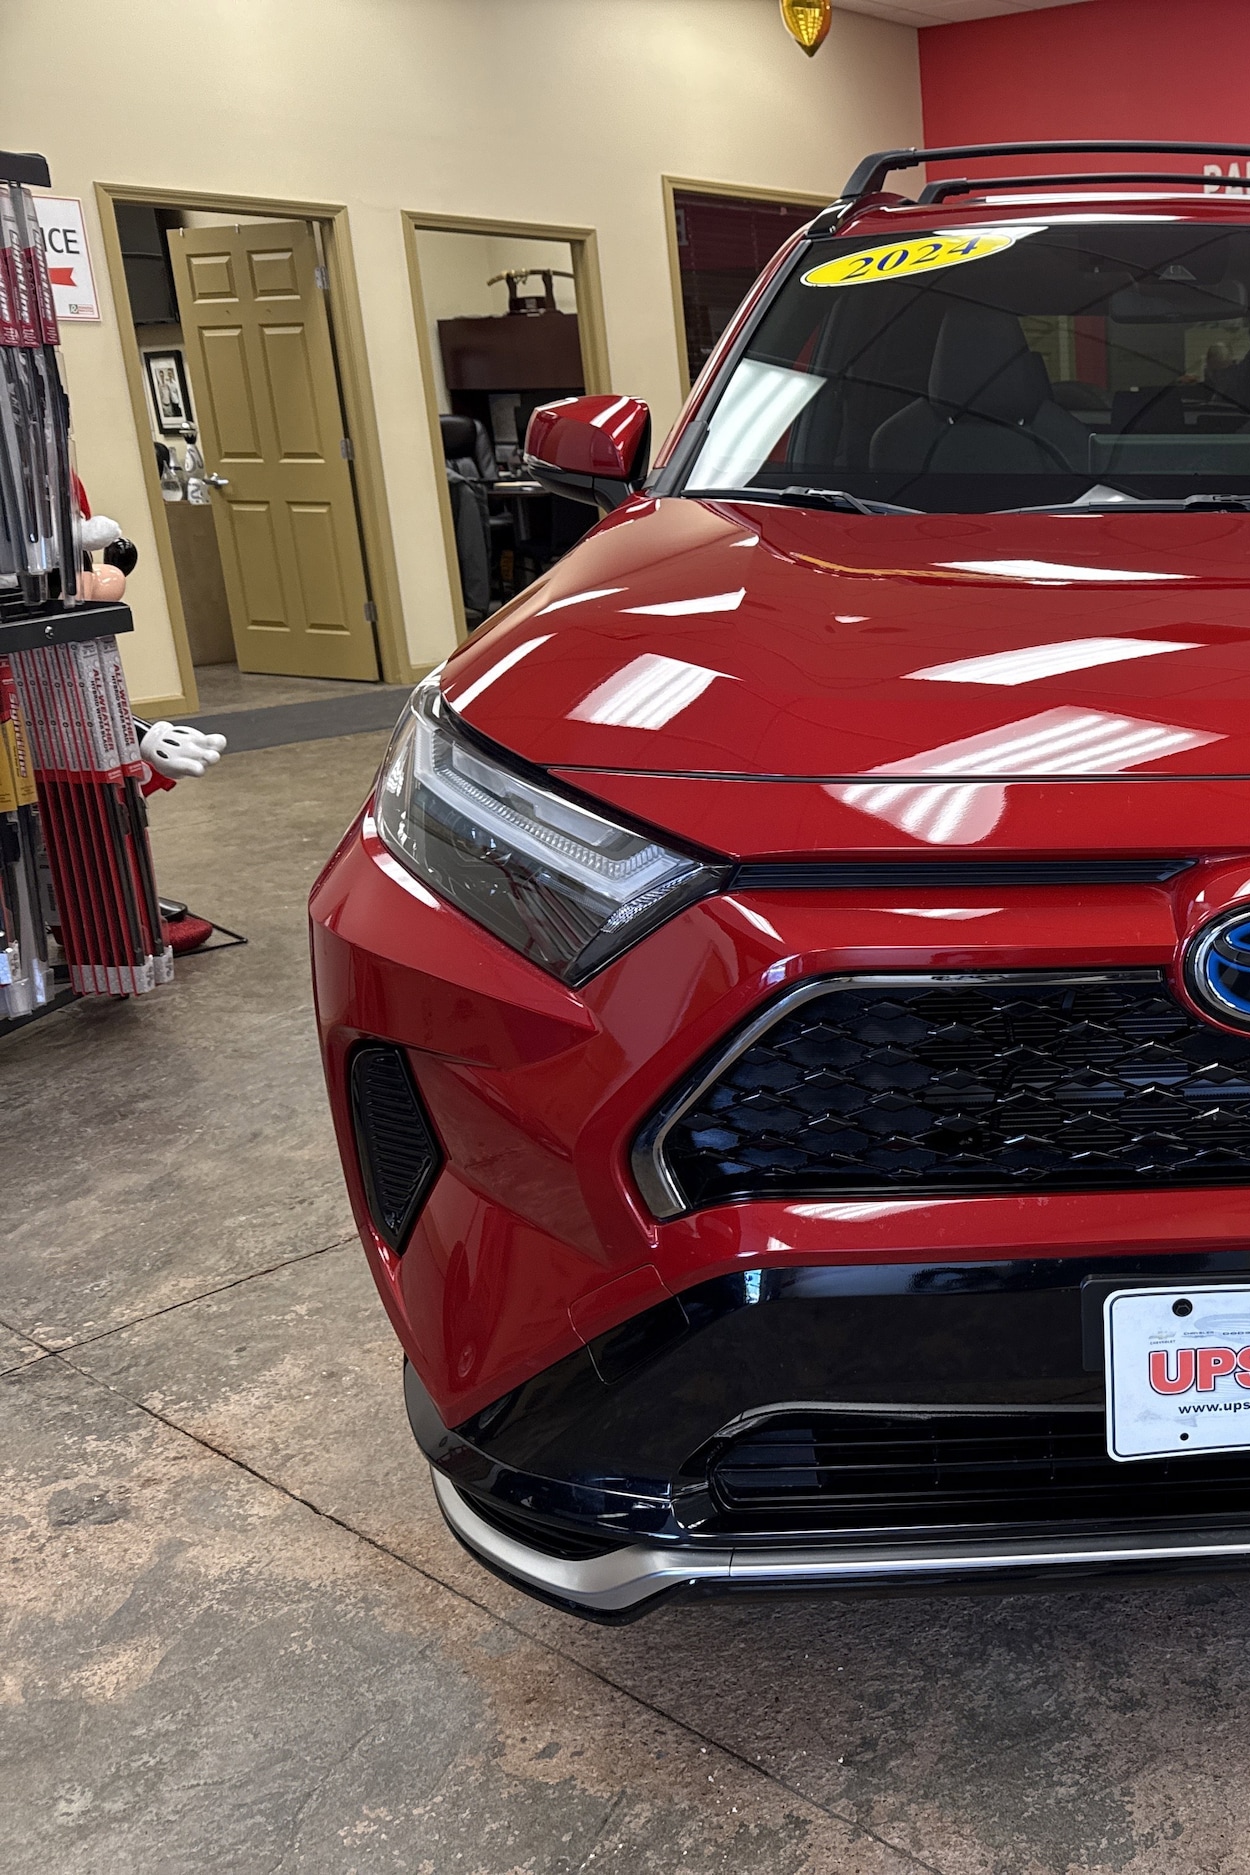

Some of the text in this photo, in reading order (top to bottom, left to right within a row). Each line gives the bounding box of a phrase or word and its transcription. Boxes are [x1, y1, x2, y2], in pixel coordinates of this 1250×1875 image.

[839, 235, 979, 282] 2024
[93, 668, 115, 751] ALL-WEATHER
[113, 663, 136, 745] ALL-WEATHER
